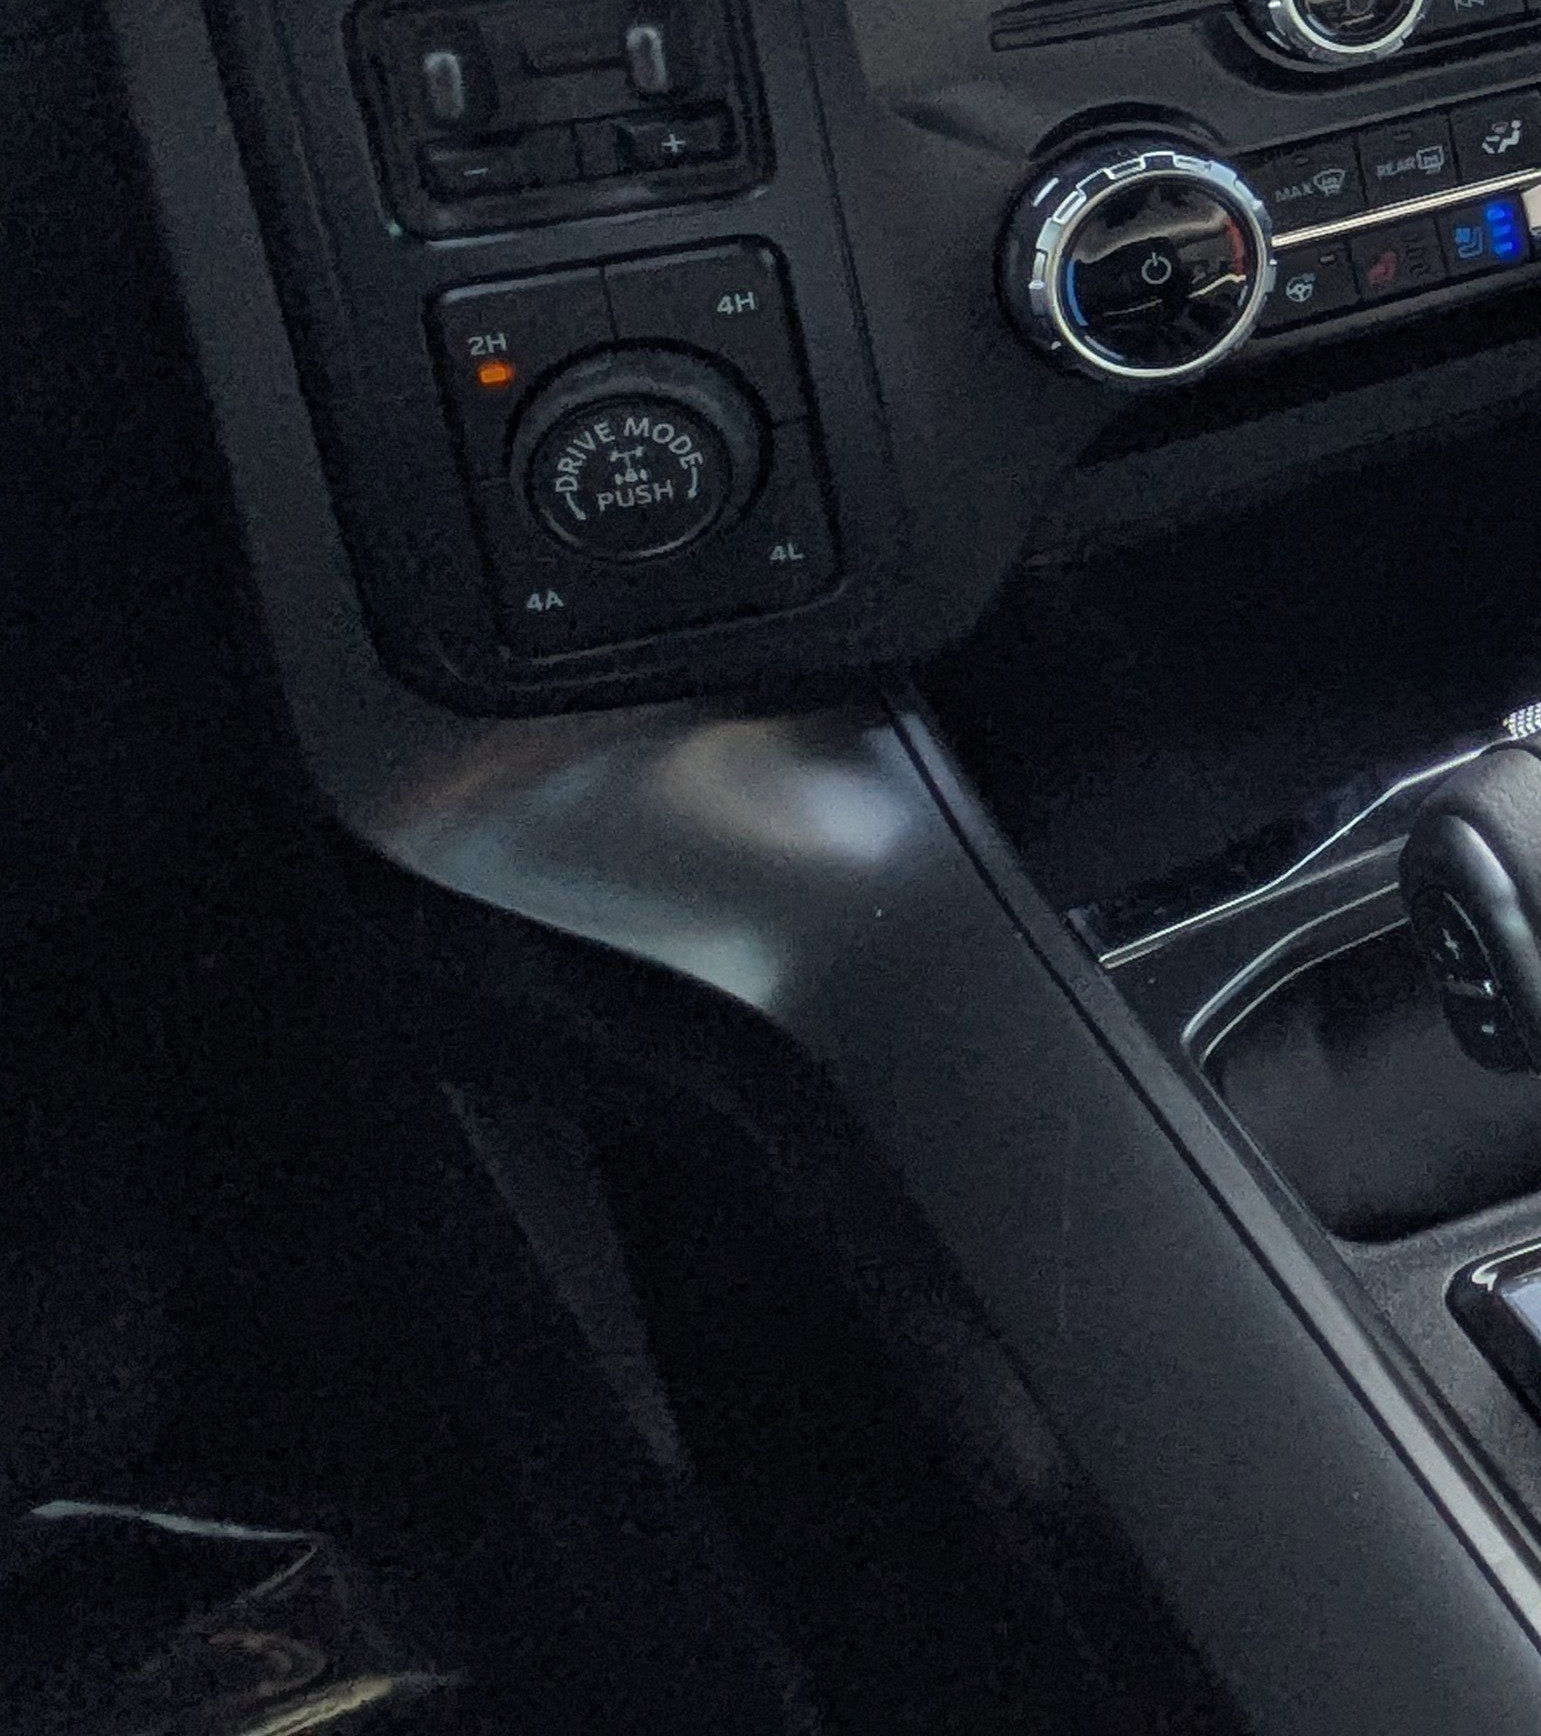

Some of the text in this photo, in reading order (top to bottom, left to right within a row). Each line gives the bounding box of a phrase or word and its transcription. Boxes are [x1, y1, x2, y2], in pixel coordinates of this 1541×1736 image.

[1275, 183, 1313, 203] MAX
[716, 291, 757, 315] 4H
[468, 332, 508, 356] 2H
[555, 416, 705, 494] DRIVE MODE
[597, 481, 675, 512] PUSH
[769, 543, 805, 562] 4L
[526, 589, 564, 612] 4A
